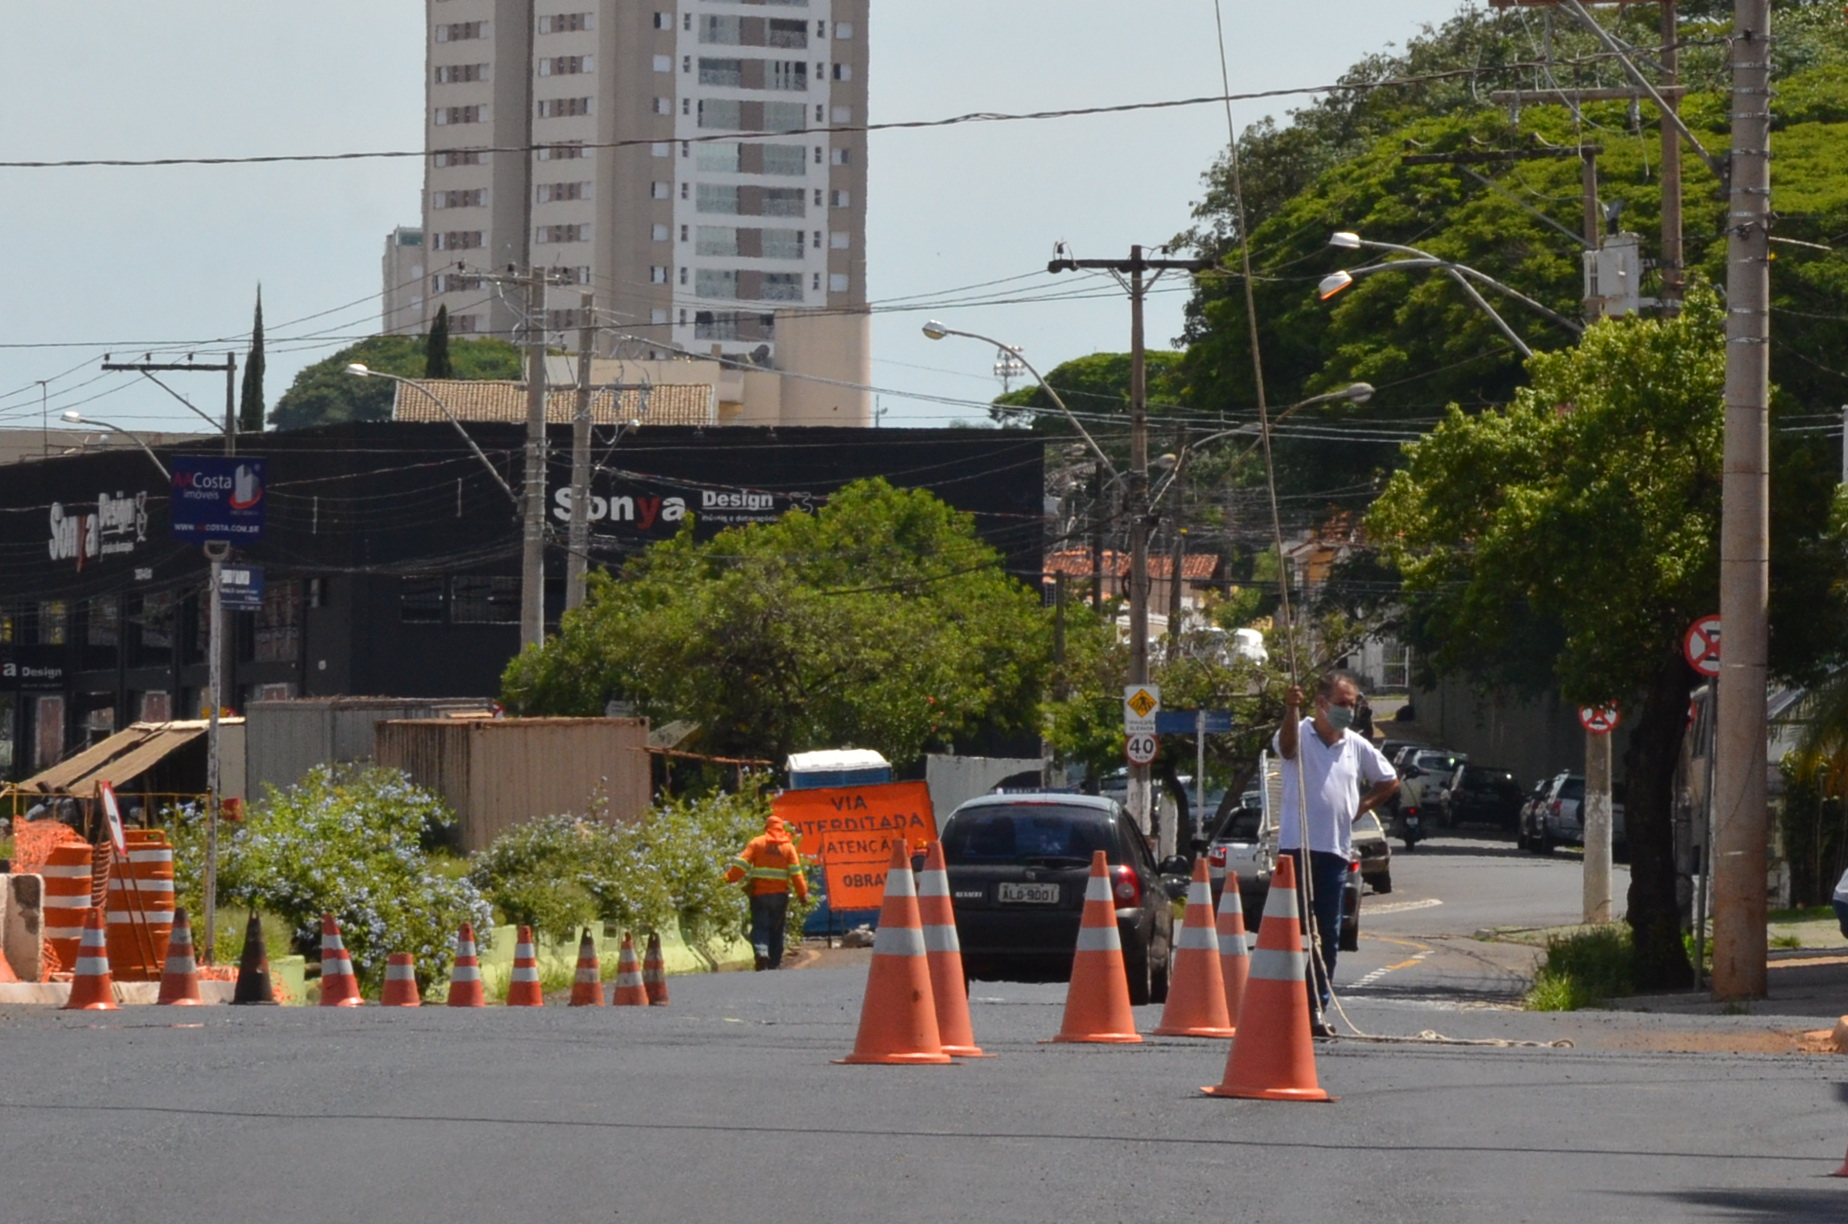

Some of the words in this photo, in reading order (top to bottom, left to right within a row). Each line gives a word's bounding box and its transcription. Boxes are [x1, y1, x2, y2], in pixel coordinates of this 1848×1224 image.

[173, 472, 232, 490] AACosta
[183, 489, 220, 501] imóveis
[553, 487, 685, 531] Sonya
[702, 489, 774, 511] Design
[49, 501, 100, 573] Sonya
[22, 665, 62, 680] Design
[1128, 738, 1155, 755] 40
[831, 795, 868, 812] VIA
[789, 812, 925, 836] NTERDITADA
[827, 835, 894, 855] ATENÇÃ
[843, 873, 888, 888] OBRA
